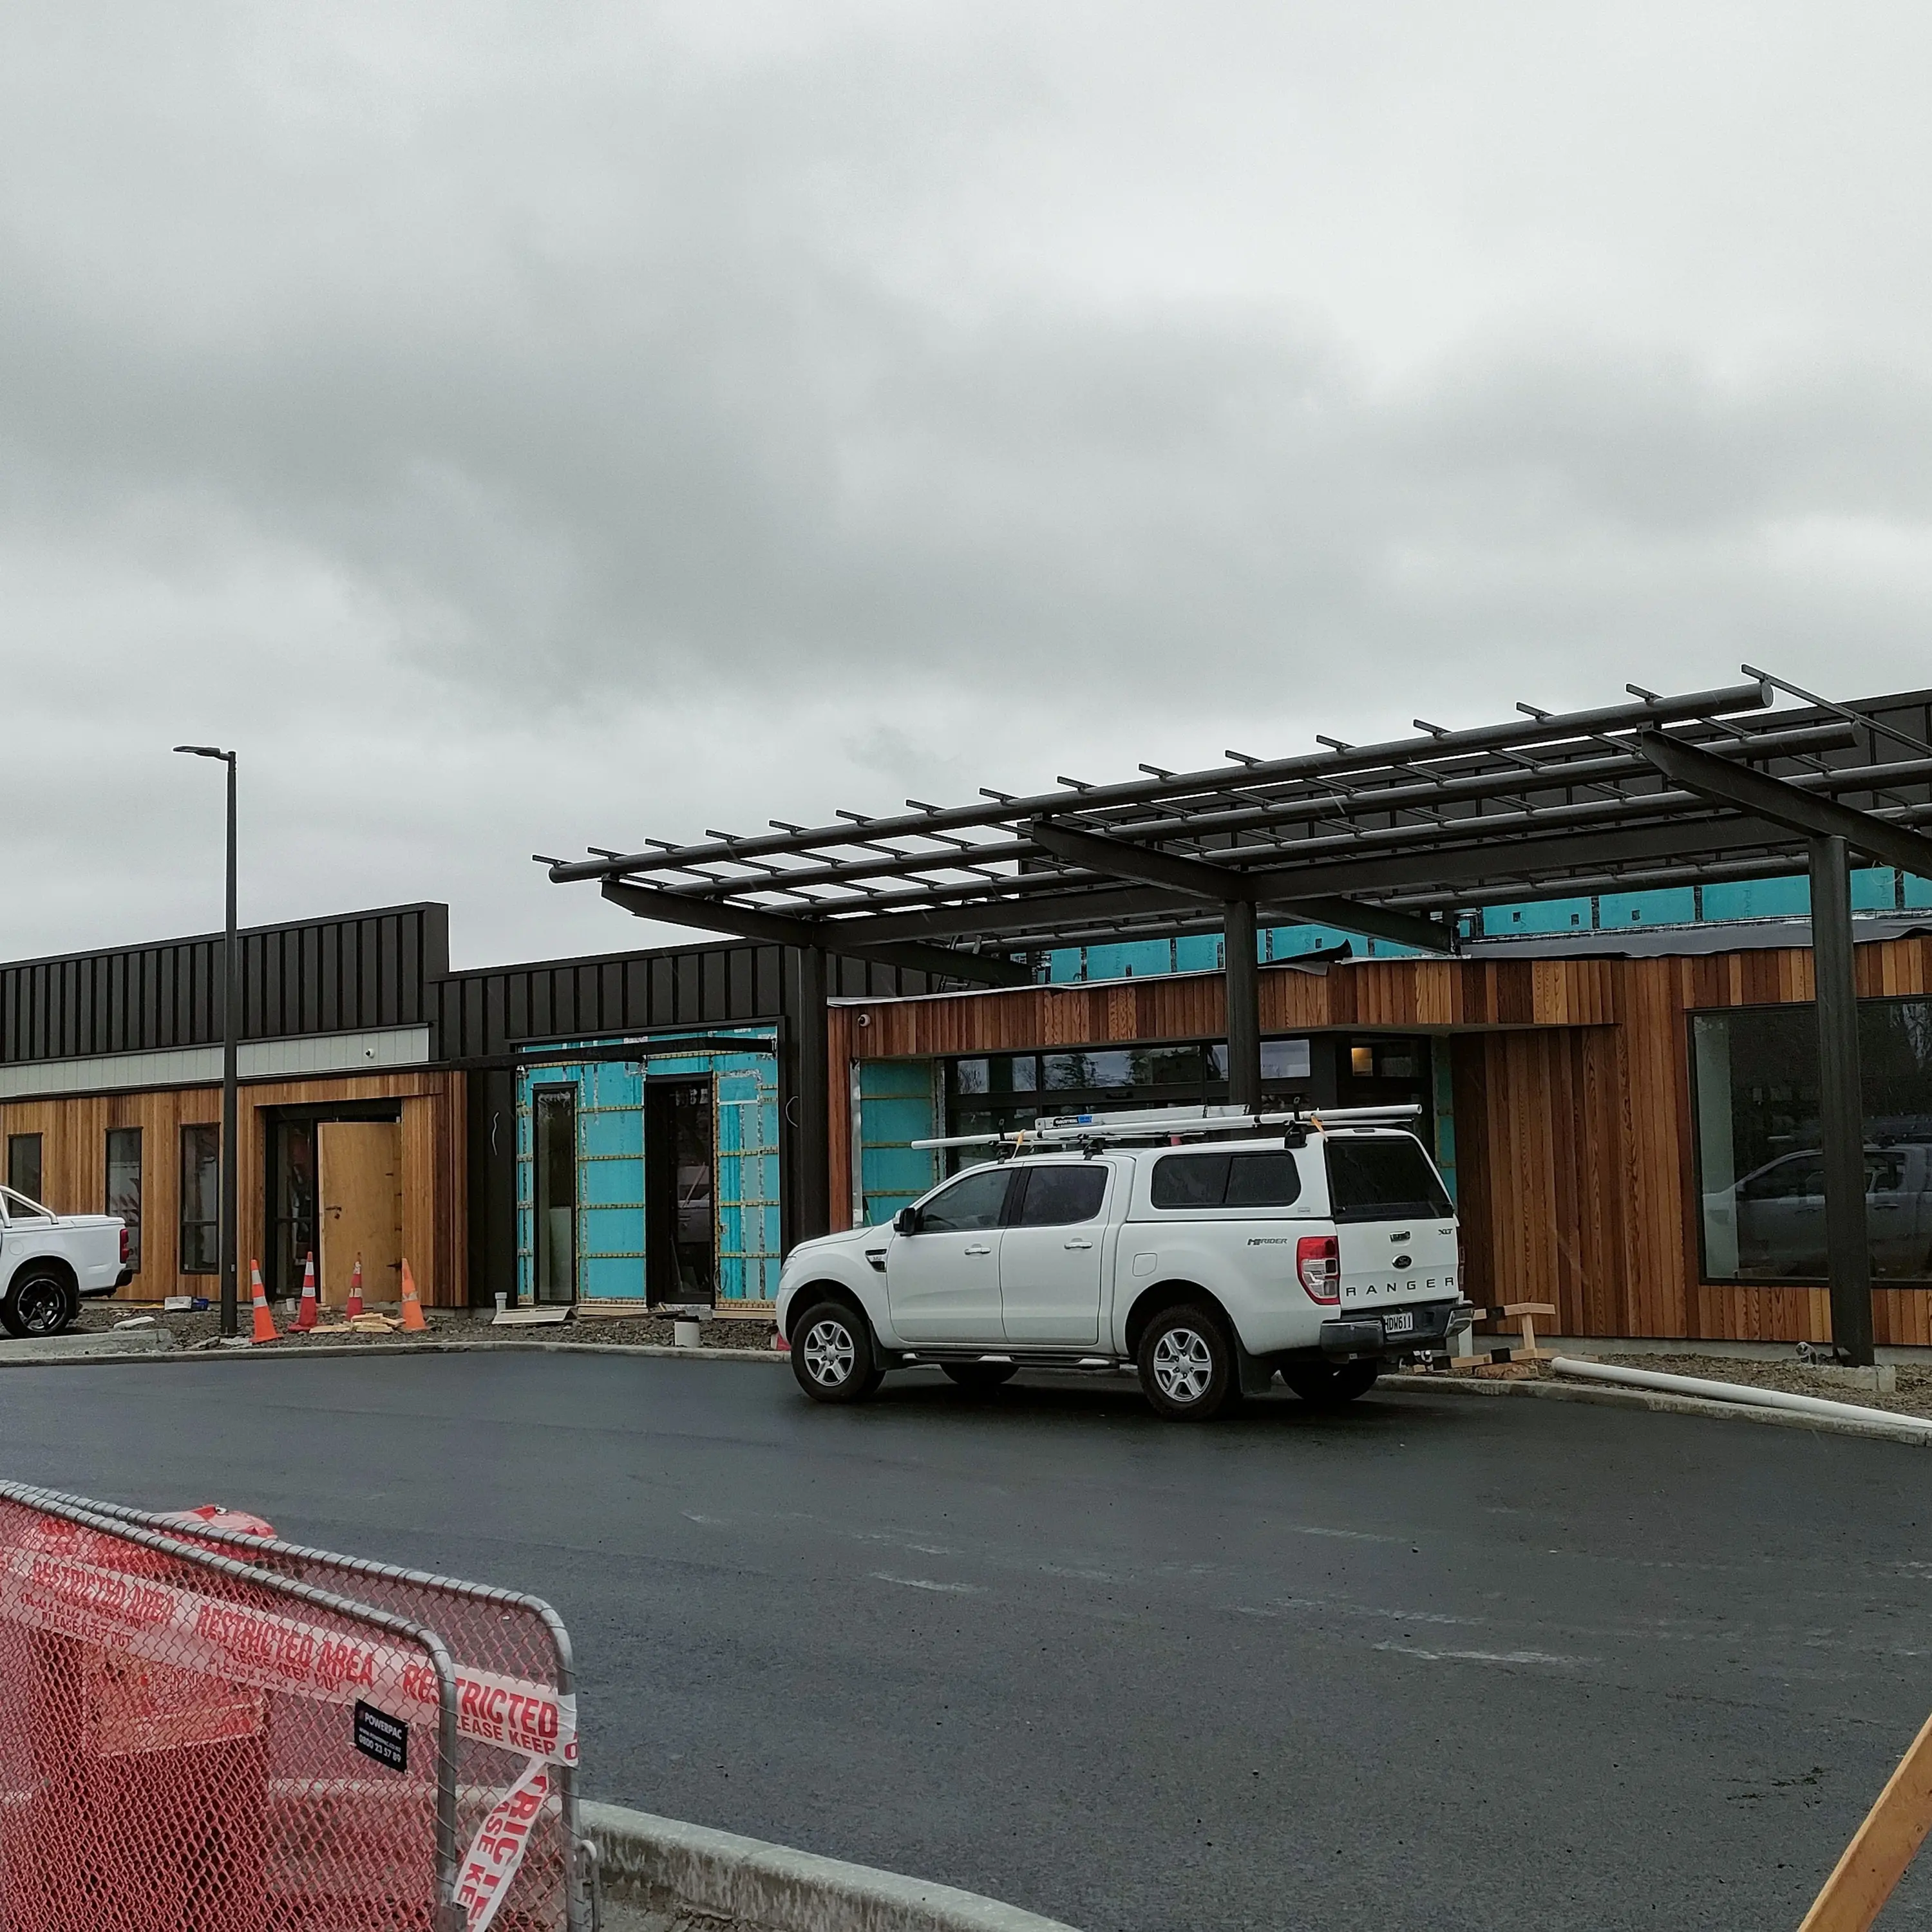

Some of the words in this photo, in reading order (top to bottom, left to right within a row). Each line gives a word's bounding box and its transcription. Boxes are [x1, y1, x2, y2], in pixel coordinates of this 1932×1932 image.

[1346, 1276, 1454, 1297] RANGER
[195, 1604, 314, 1668] RESTRICTED
[316, 1639, 376, 1687] AREA
[365, 1712, 402, 1740] POWERPAC
[359, 1734, 373, 1749] 0800
[375, 1743, 383, 1754] 23
[384, 1748, 392, 1757] 57
[393, 1752, 401, 1763] 89
[508, 1729, 556, 1756] KEEP
